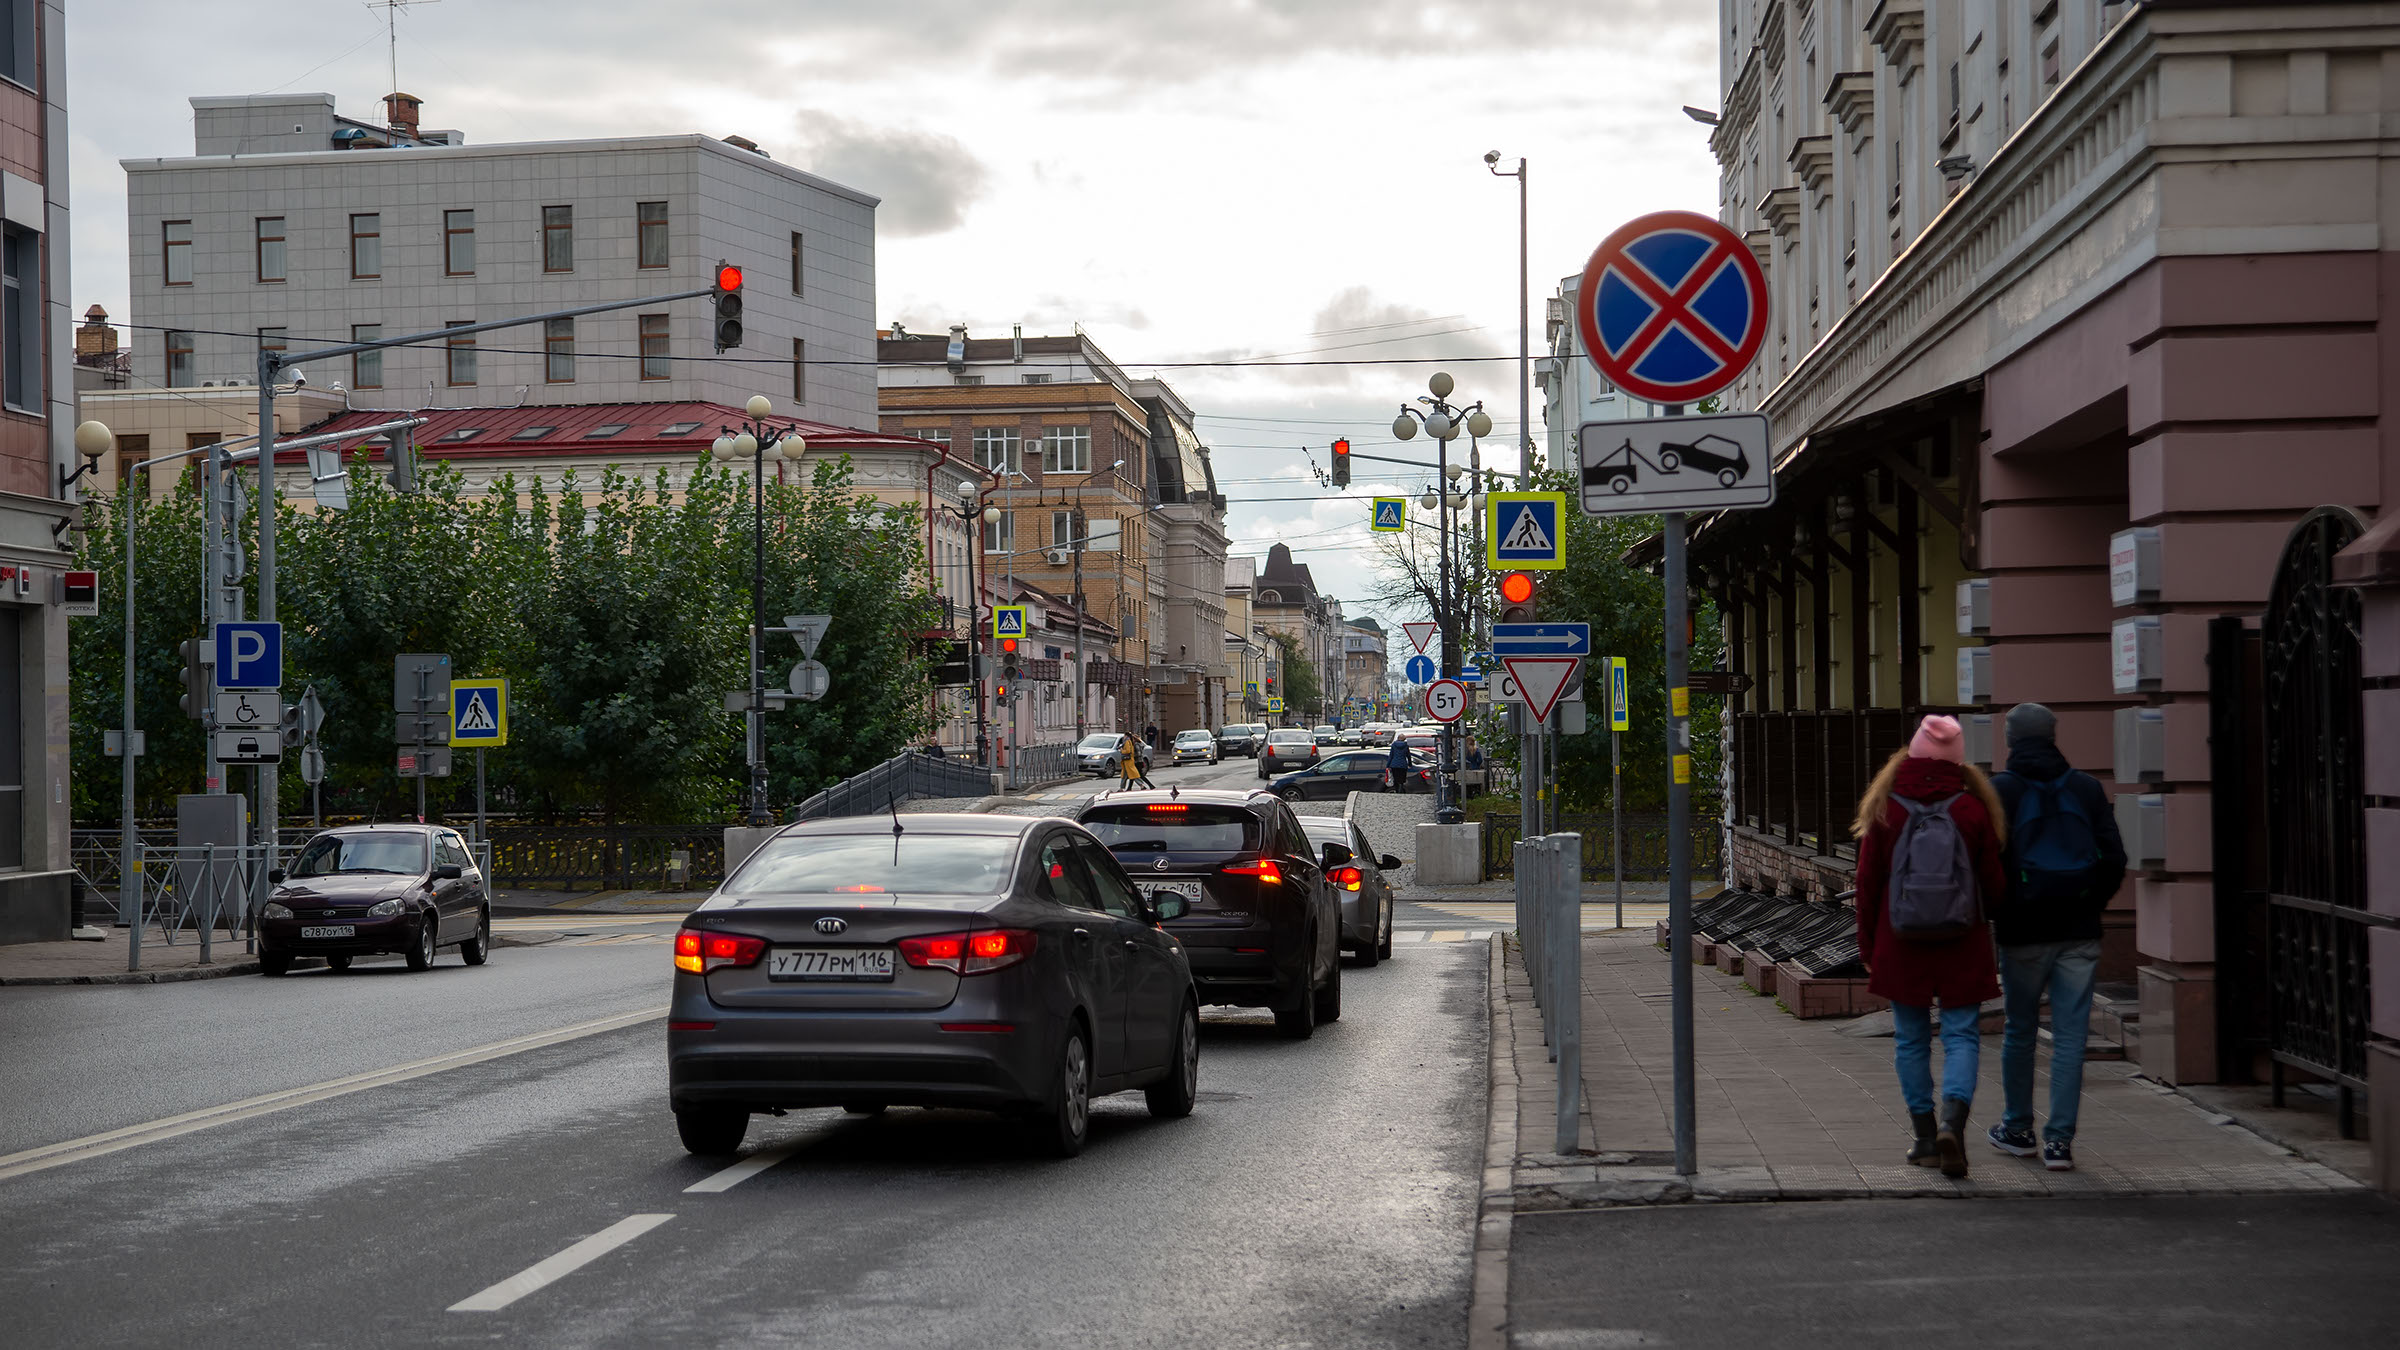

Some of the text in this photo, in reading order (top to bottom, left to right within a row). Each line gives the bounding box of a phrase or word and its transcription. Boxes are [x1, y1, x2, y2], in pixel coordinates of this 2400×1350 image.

[231, 630, 266, 680] P
[1178, 883, 1198, 894] 716
[818, 921, 842, 932] KIA
[858, 952, 887, 967] 116
